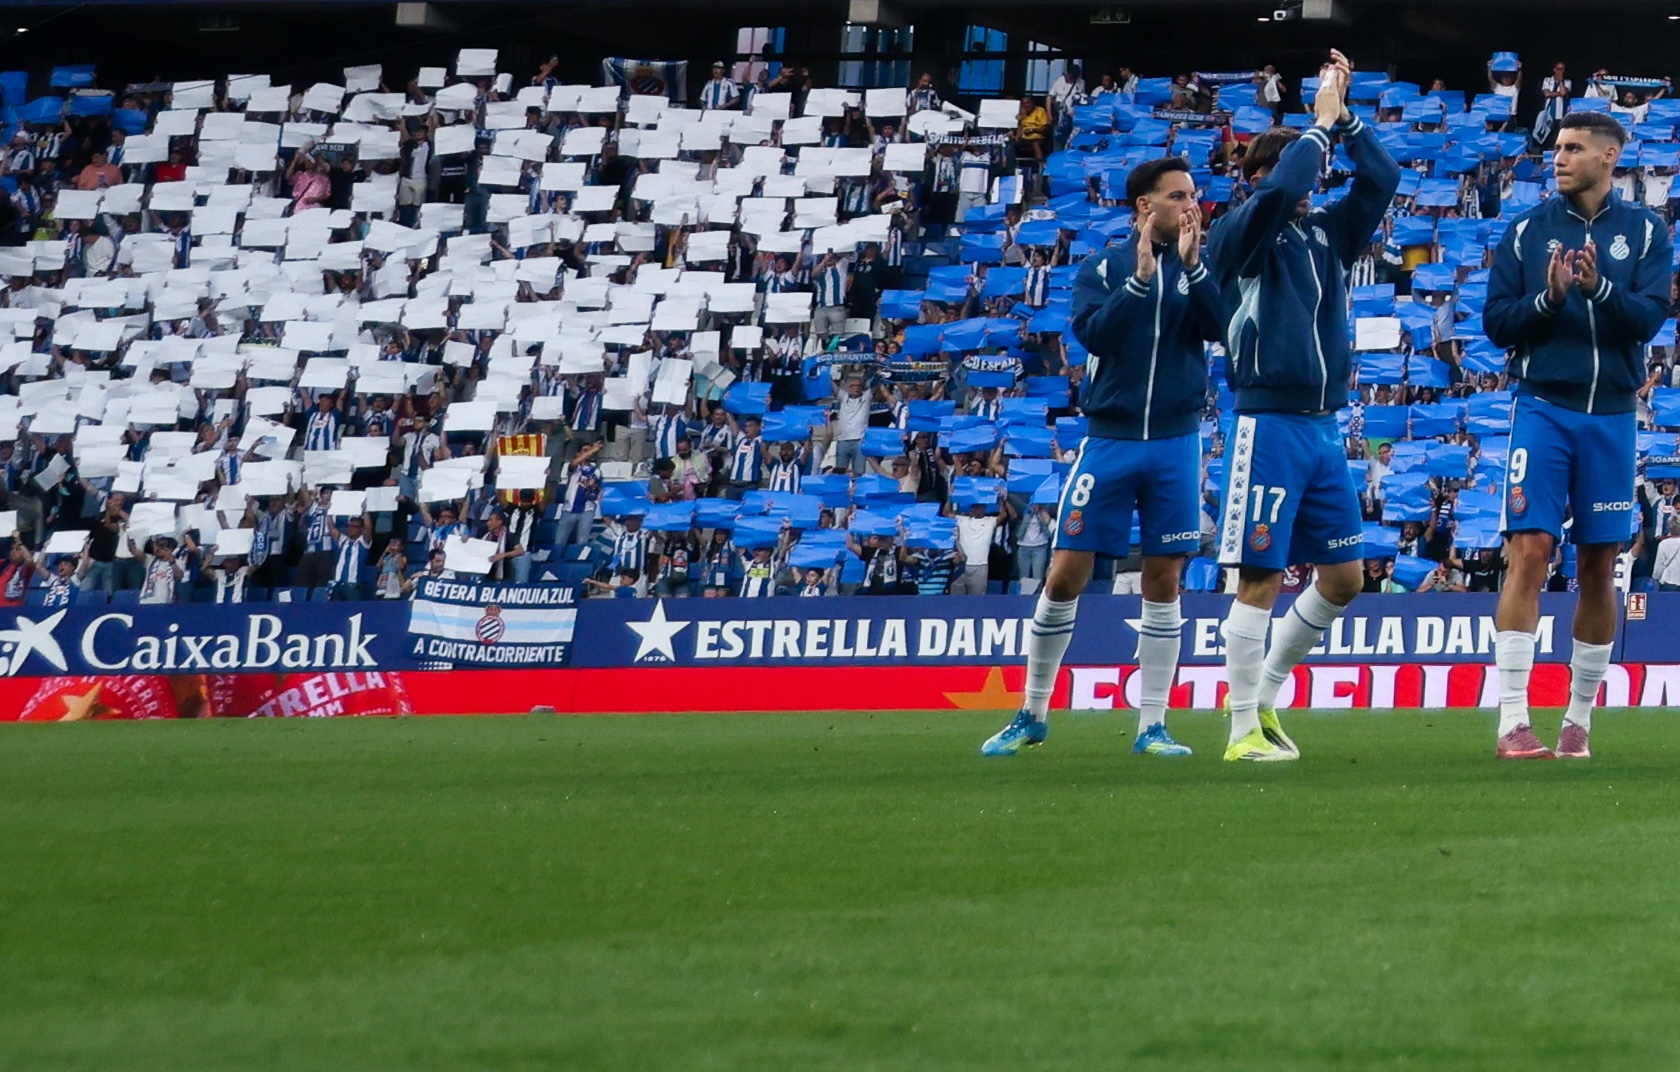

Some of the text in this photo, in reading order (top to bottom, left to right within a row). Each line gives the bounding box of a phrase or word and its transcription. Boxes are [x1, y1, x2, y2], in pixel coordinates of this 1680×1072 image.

[834, 353, 876, 362] ESPANYOL
[981, 357, 1016, 370] ESPAN
[1509, 447, 1528, 484] 9
[1072, 473, 1095, 507] 8
[1252, 485, 1287, 524] 17
[1162, 531, 1200, 542] SKOD
[1329, 536, 1363, 549] SKOD
[425, 580, 576, 605] BÉTERA BLANQUIAZUL
[82, 613, 378, 670] CaixaBank
[414, 637, 566, 664] A CONTRACORRIENTE
[695, 619, 907, 658] ESTRELLA
[1194, 617, 1404, 656] ESELLA
[247, 672, 387, 718] TRELLA
